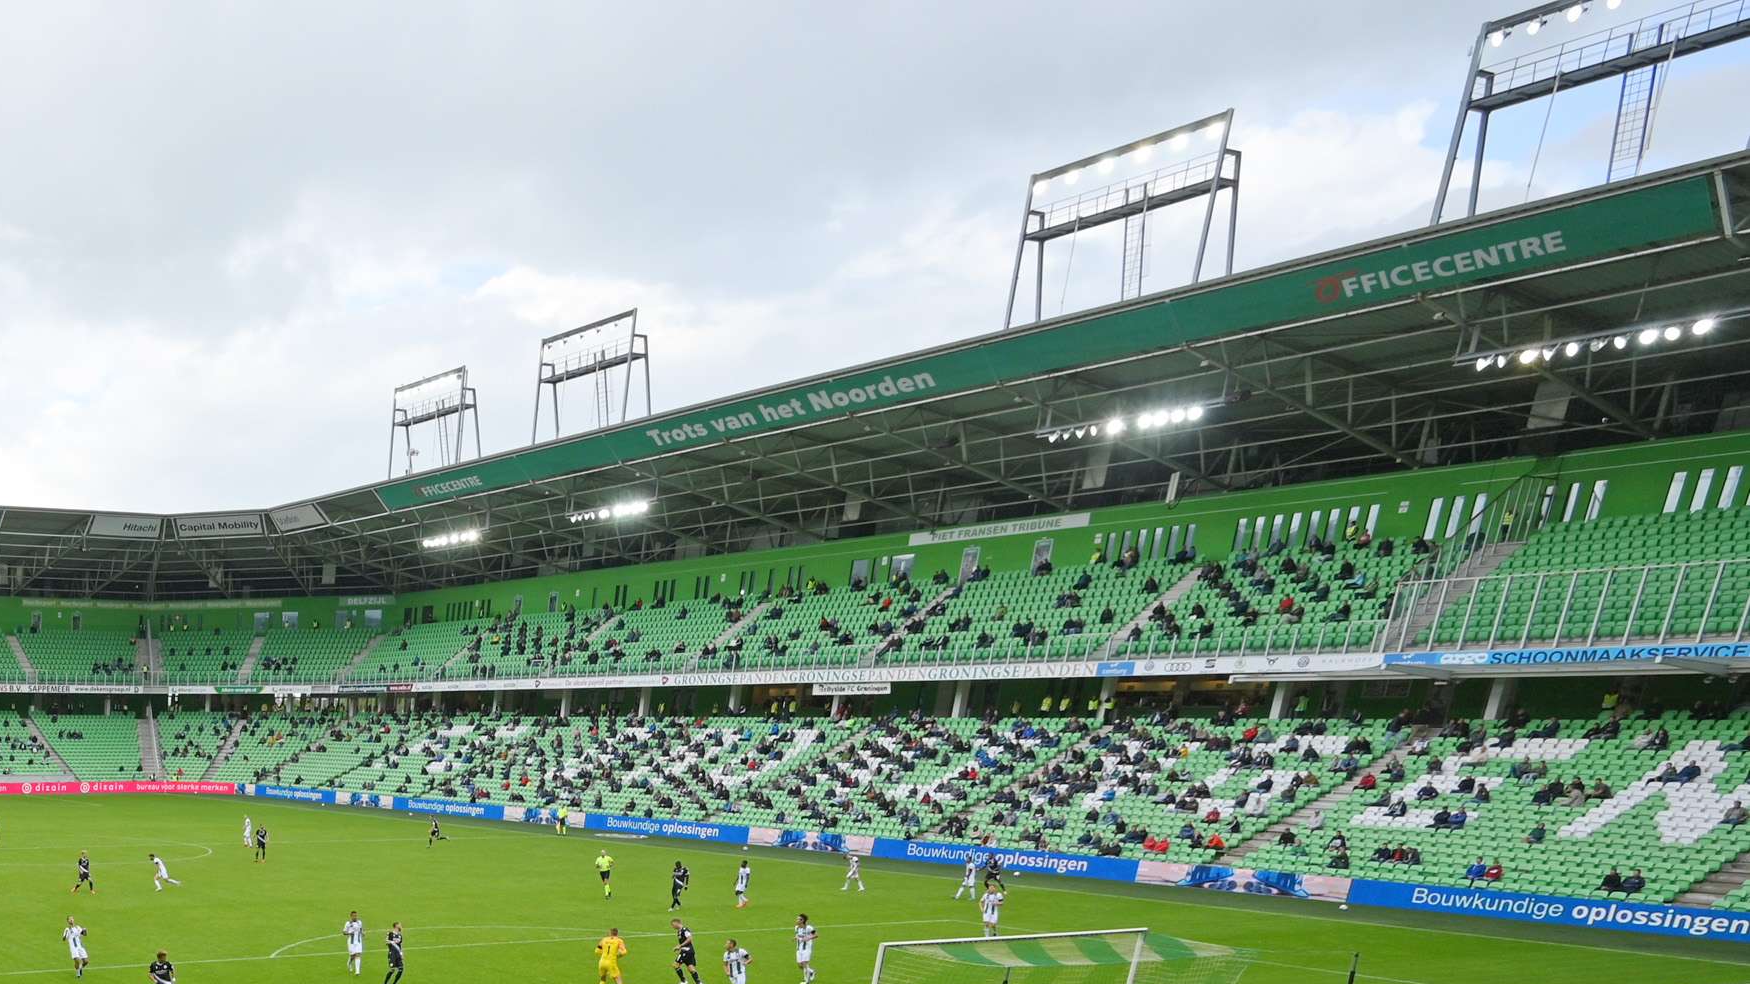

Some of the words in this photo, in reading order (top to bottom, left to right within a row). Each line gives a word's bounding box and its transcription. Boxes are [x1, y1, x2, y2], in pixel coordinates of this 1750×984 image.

[1313, 230, 1567, 303] OFFICECENTRE
[646, 423, 708, 447] Trots
[711, 411, 756, 433] van
[758, 398, 807, 422] het
[808, 371, 937, 412] Noorden
[122, 521, 157, 532] Hitachi
[179, 522, 215, 533] Capital
[218, 520, 259, 531] Mobility
[932, 531, 954, 541] PIET
[957, 524, 1009, 539] FRANSEN
[1011, 519, 1062, 533] TRIBUNE
[1489, 645, 1748, 664] SCHOONMAAKSERVICE
[28, 684, 70, 692] SAPPEMEER
[856, 684, 888, 693] Groningen
[35, 783, 67, 792] dizain
[93, 783, 123, 791] dizain
[266, 787, 294, 799] Bouwkundige
[293, 790, 322, 801] oplossingen
[408, 800, 445, 812] Bouwkundige
[445, 802, 485, 816] oplossingen
[606, 817, 660, 833] Bouwkundige
[662, 823, 720, 839] oplossingen
[906, 843, 989, 864] Bouwkundige
[995, 851, 1088, 874] oplossingen
[1411, 887, 1564, 920] Bouwkundige
[1571, 904, 1750, 935] oplossingen
